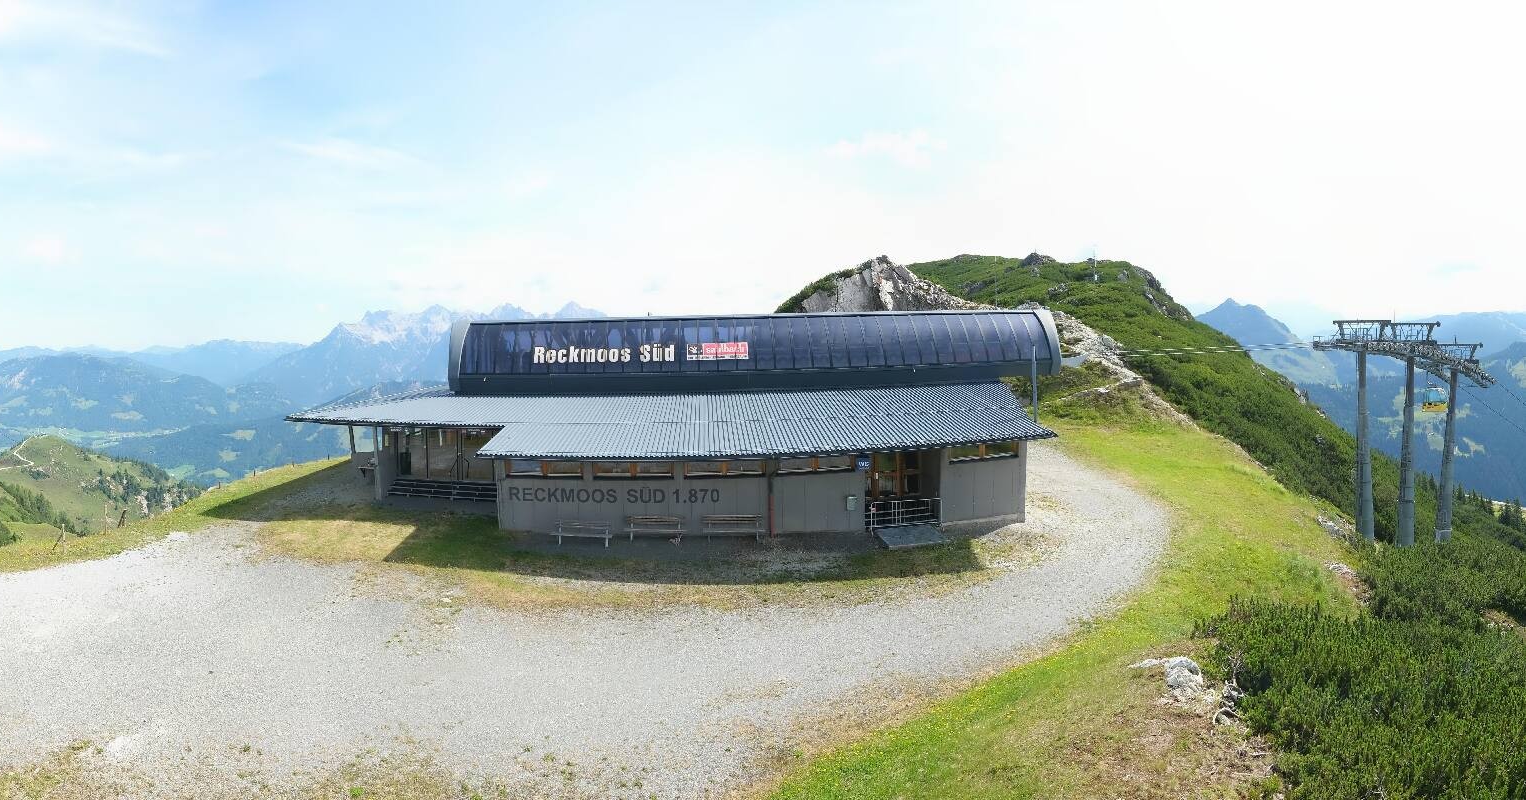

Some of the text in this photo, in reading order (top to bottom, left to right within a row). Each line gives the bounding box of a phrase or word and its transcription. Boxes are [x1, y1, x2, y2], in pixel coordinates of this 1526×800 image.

[533, 343, 675, 364] Reckmoos Süd
[508, 485, 720, 504] RECKMOOS SÜD 1.870
